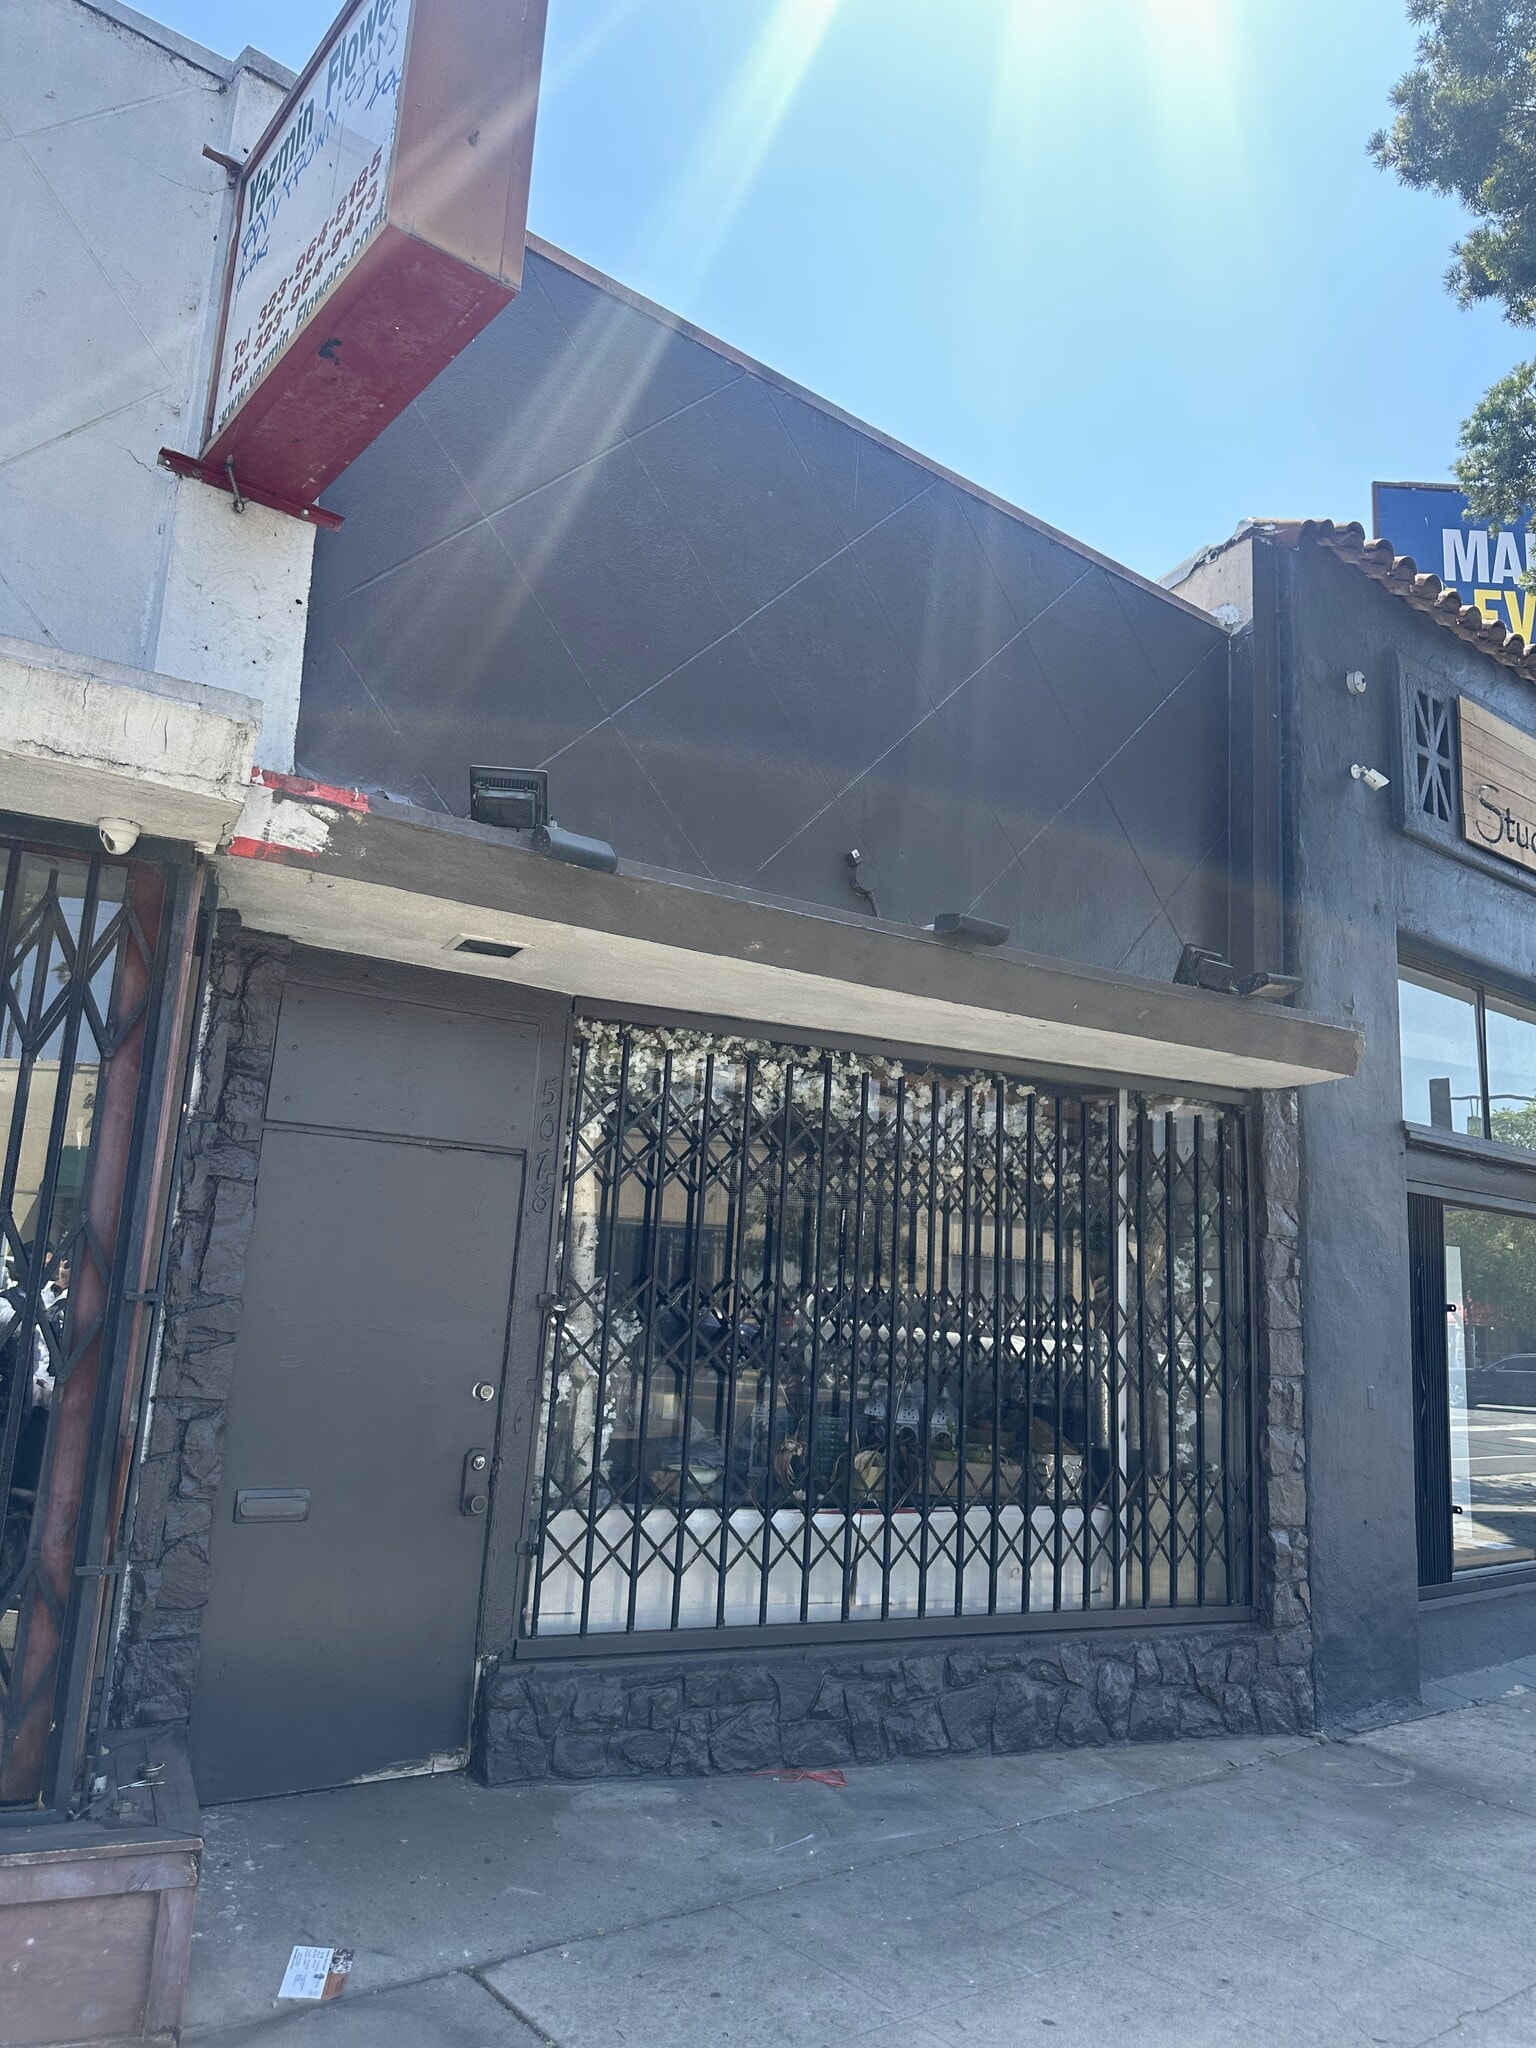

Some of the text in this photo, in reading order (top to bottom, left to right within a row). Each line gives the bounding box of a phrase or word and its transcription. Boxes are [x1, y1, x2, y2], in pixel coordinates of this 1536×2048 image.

[248, 97, 315, 223] Yazmin
[325, 0, 398, 110] Flowe
[229, 180, 378, 392] Fax 323-964-9473
[234, 327, 252, 364] Tel
[258, 145, 383, 330] 323-964-8185
[1475, 784, 1536, 854] Stu
